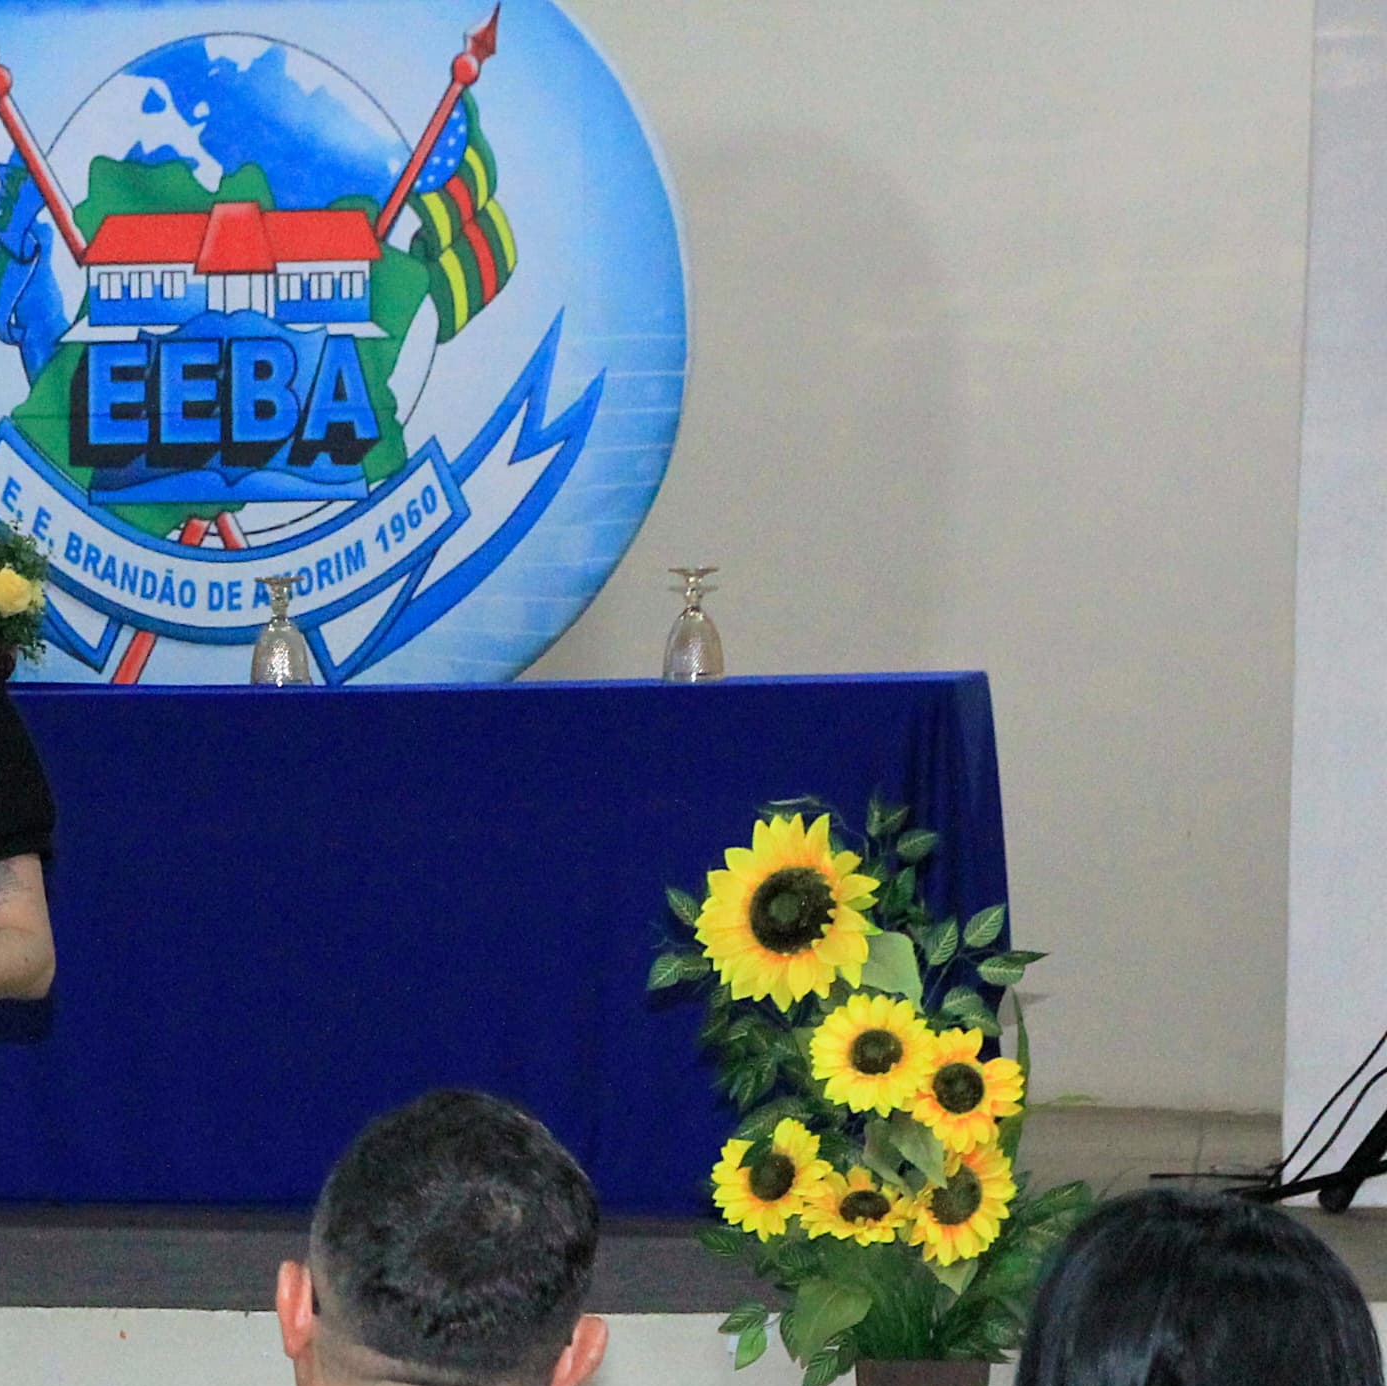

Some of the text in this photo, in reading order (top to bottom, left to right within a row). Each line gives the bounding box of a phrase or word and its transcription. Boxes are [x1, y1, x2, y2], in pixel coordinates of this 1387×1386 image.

[77, 333, 380, 450] EEBA
[1, 476, 439, 612] E. E. BRANDÃO DE AORIM 1960
